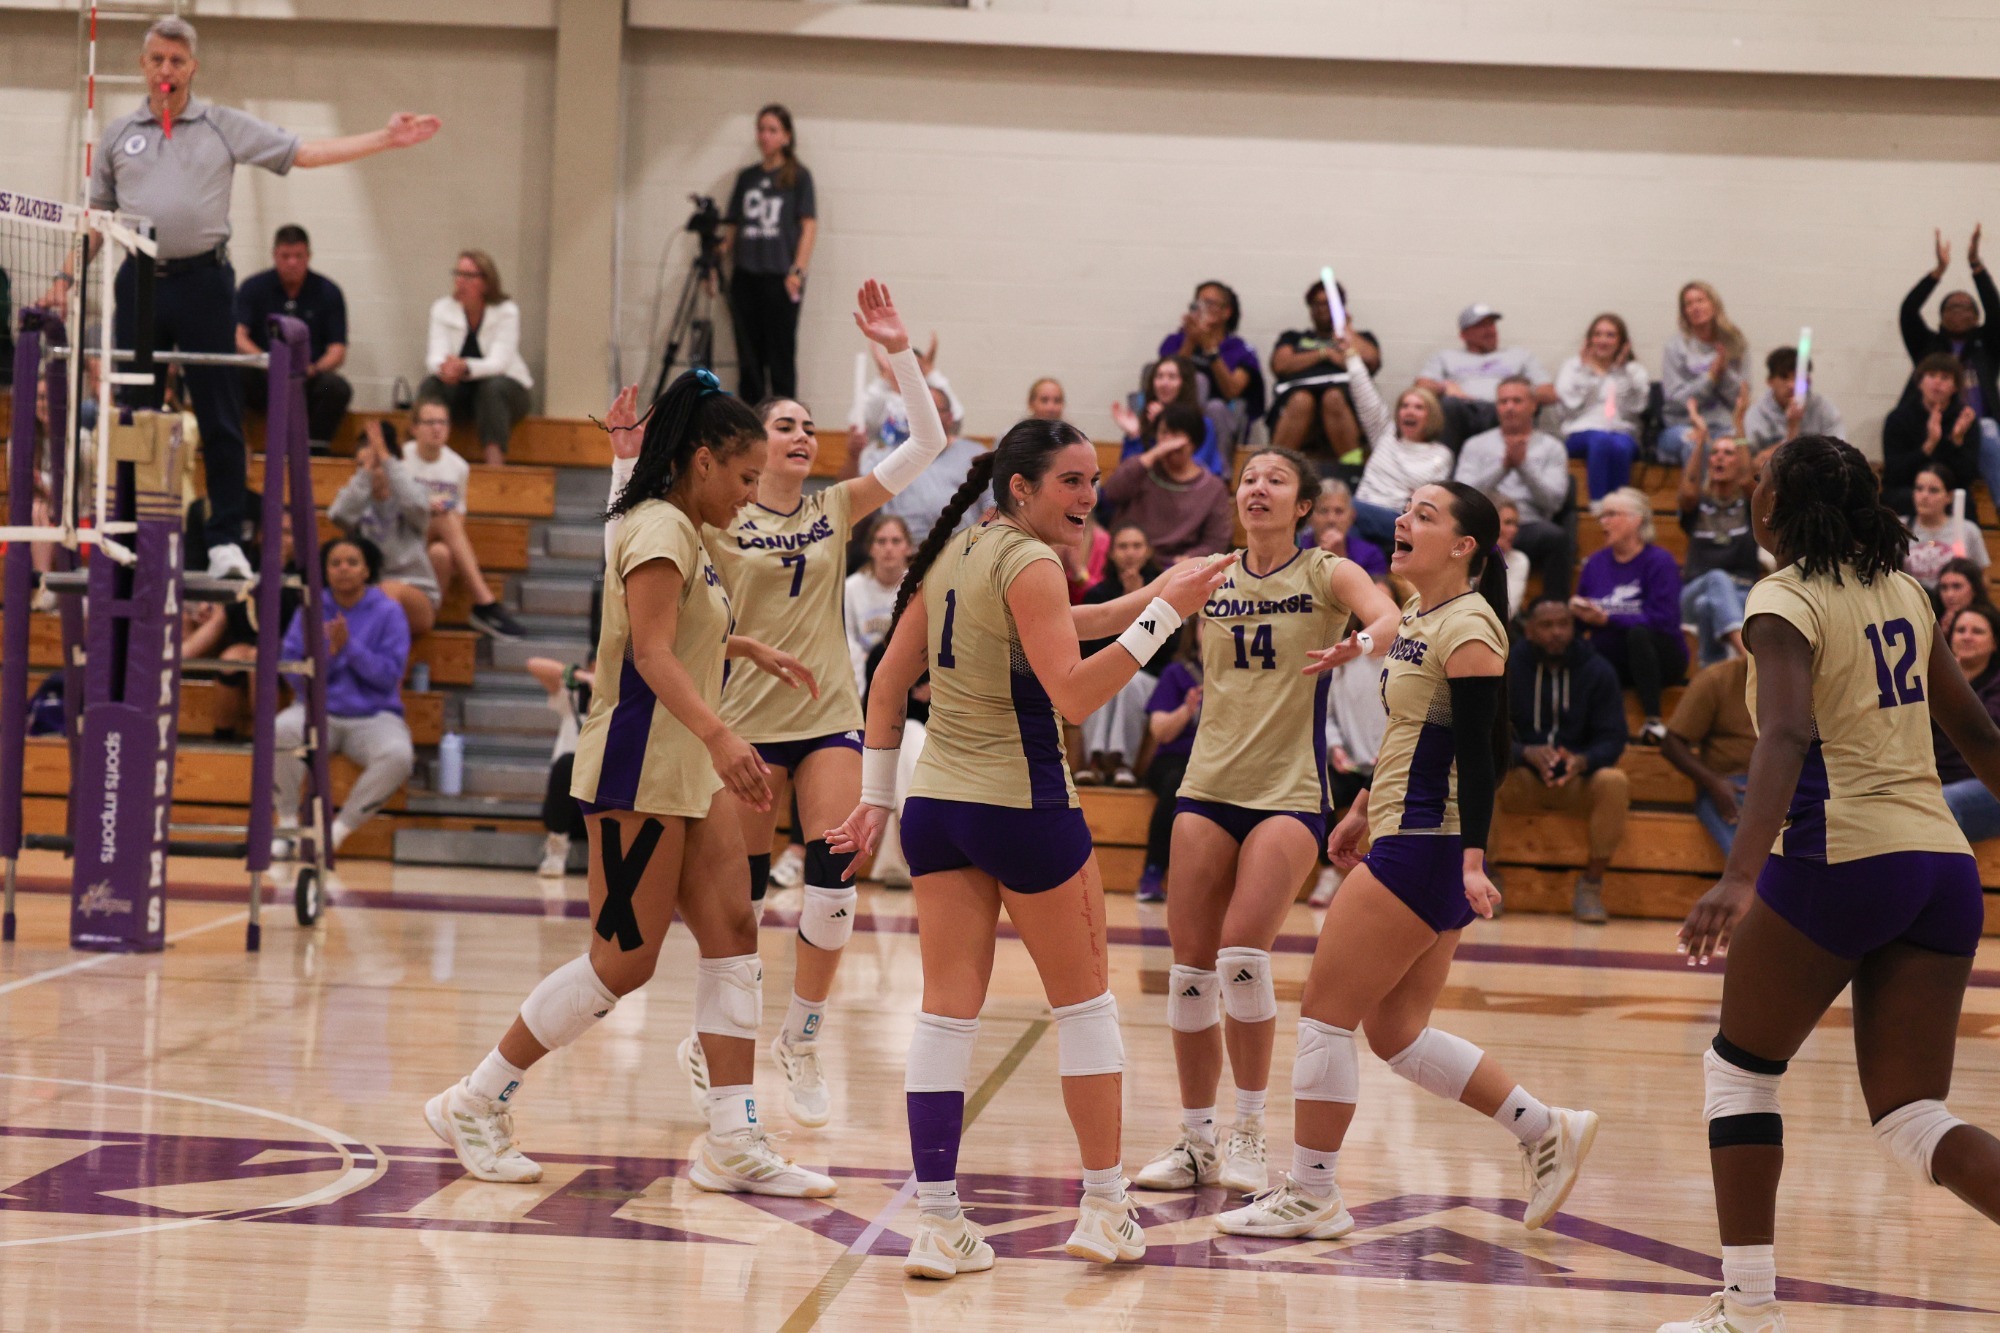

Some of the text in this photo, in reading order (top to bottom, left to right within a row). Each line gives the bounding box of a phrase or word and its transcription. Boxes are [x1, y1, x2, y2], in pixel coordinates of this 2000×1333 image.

[781, 554, 806, 598] 7
[937, 588, 957, 670] 1
[1230, 623, 1276, 670] 14
[1863, 617, 1926, 709] 12
[100, 730, 122, 864] sports imports
